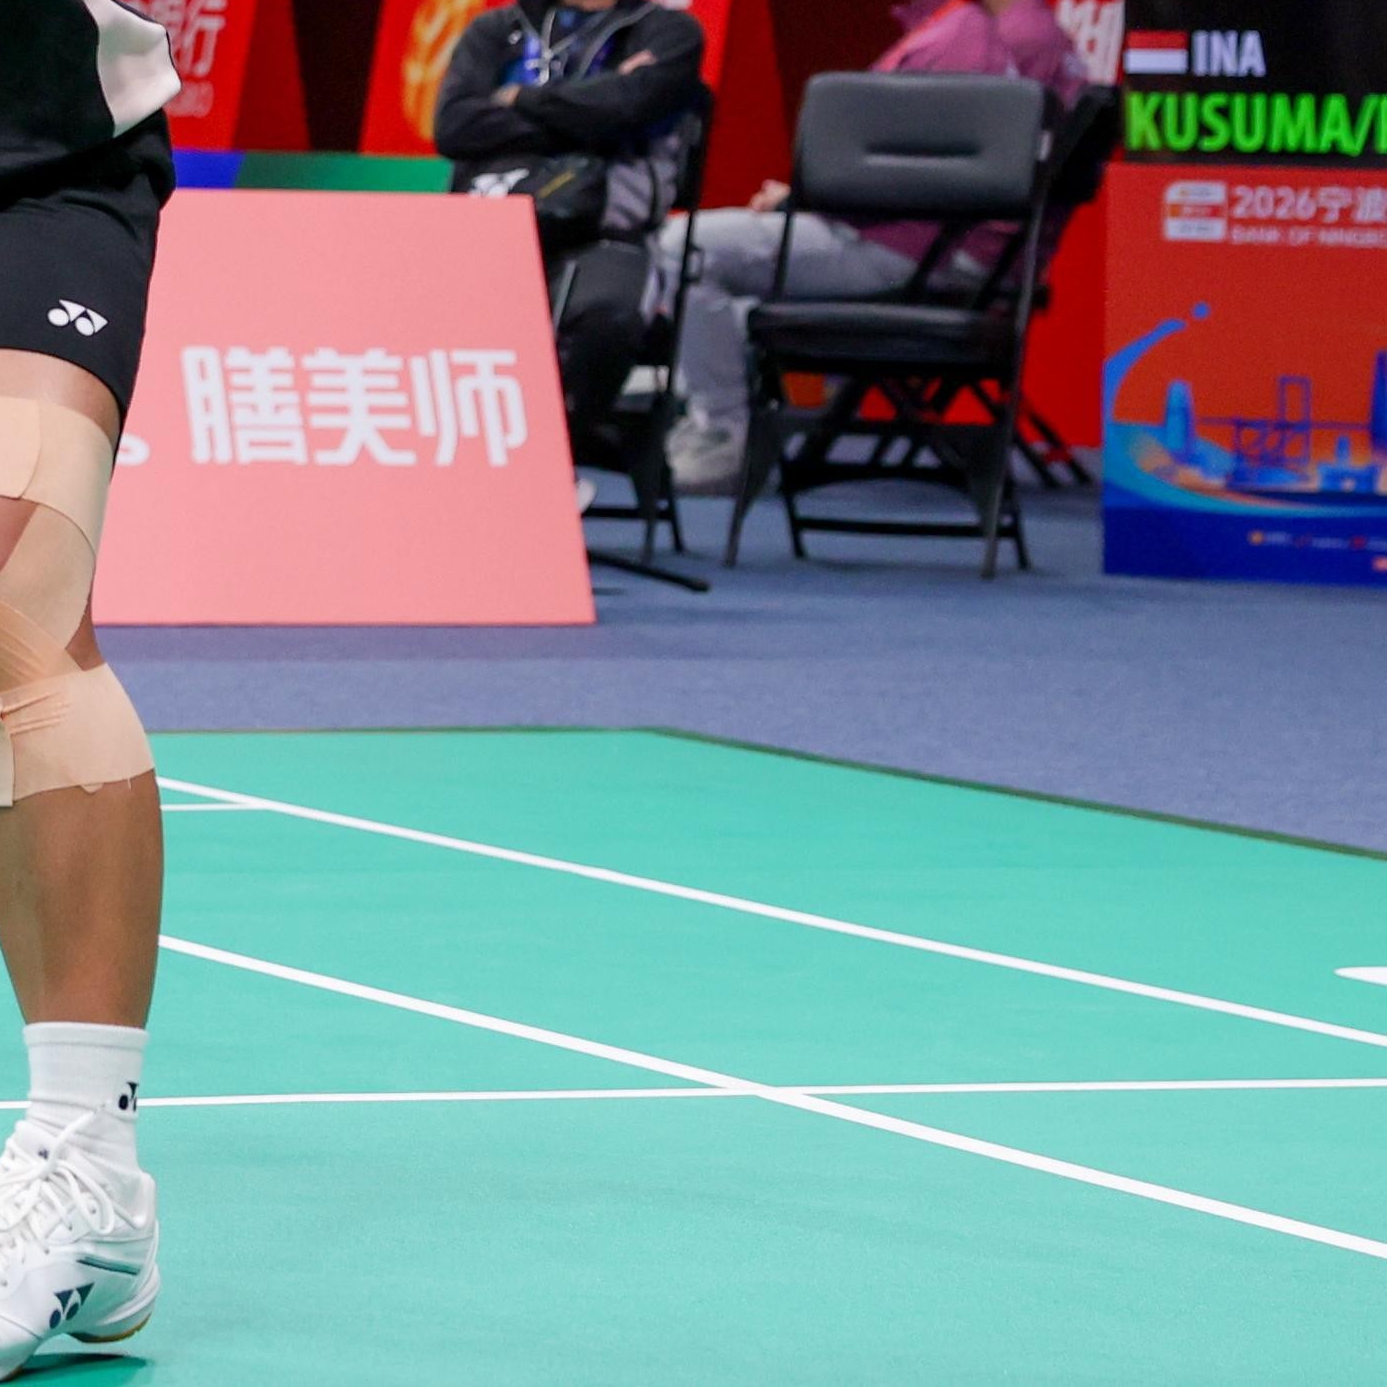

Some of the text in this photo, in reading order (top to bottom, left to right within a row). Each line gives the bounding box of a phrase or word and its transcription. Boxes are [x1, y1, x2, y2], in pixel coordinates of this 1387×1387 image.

[1191, 29, 1266, 77] INA
[180, 345, 528, 467] 膳美师
